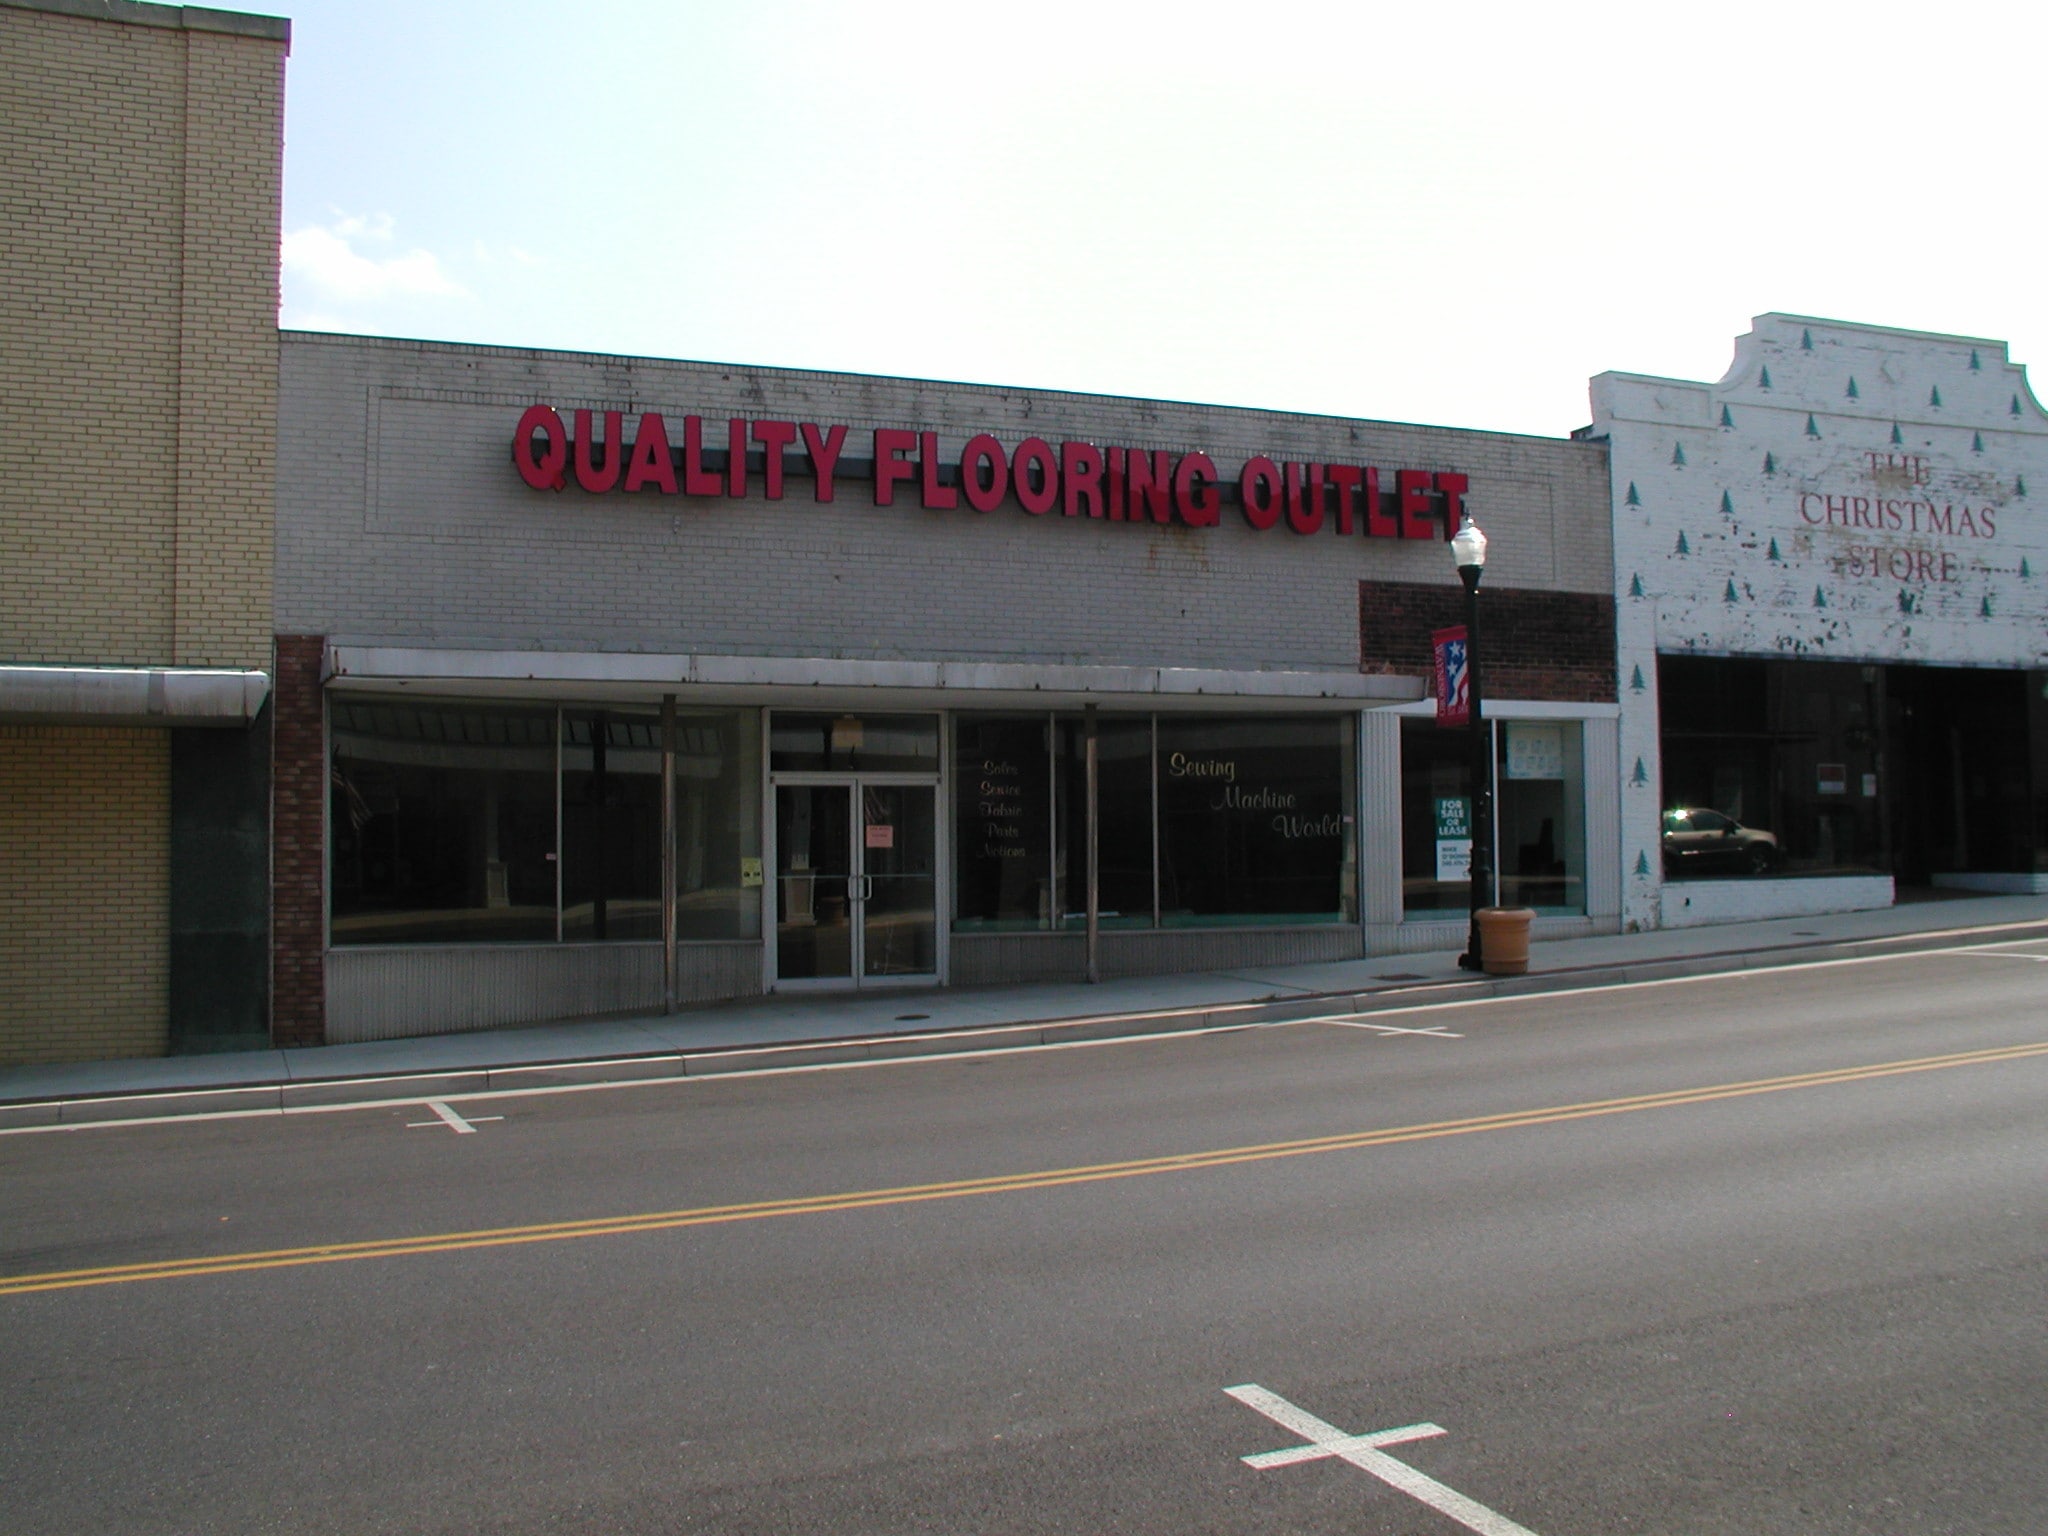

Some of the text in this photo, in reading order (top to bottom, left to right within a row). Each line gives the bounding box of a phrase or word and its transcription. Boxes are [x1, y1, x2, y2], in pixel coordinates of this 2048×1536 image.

[513, 404, 1468, 542] QUALITY FLOORING OUTLET
[1865, 452, 1931, 486] THE
[1800, 492, 1996, 539] CHRISTMAS
[1848, 544, 1957, 583] STORE
[1169, 752, 1235, 783] Sewing
[1209, 786, 1297, 810] Machine
[1443, 800, 1462, 809] FOR
[1442, 809, 1464, 818] SALE
[1446, 818, 1459, 826] OR
[1272, 814, 1341, 838] World
[1438, 826, 1467, 836] LEASE
